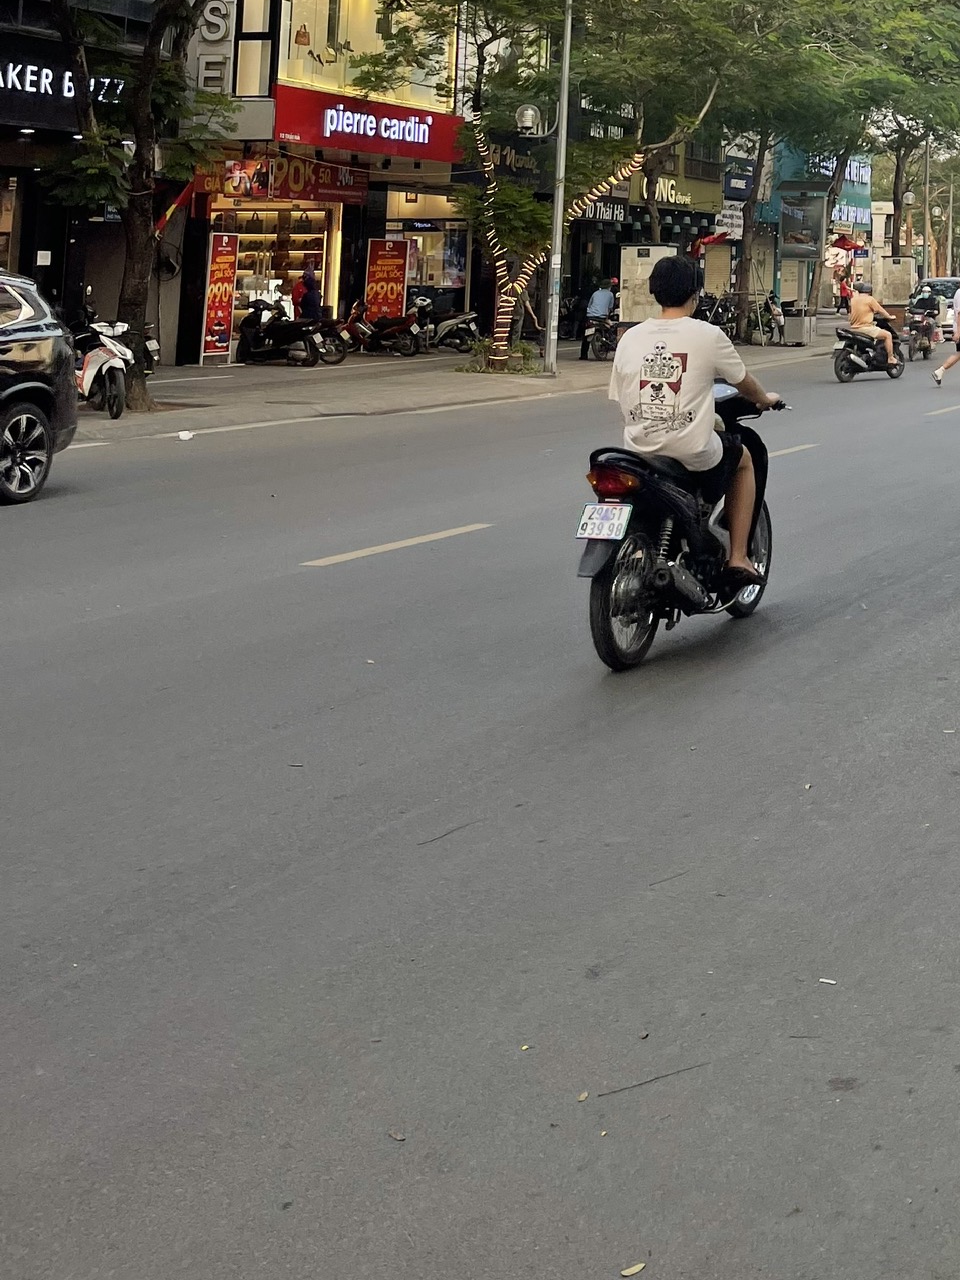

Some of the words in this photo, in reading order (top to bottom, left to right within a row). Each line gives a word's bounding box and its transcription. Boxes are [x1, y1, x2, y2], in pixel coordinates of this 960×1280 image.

[324, 104, 377, 137] pierre
[380, 116, 433, 144] cardin
[643, 177, 676, 204] CNG
[596, 202, 613, 220] Thái
[613, 204, 625, 221] Hà
[367, 282, 404, 300] 990K
